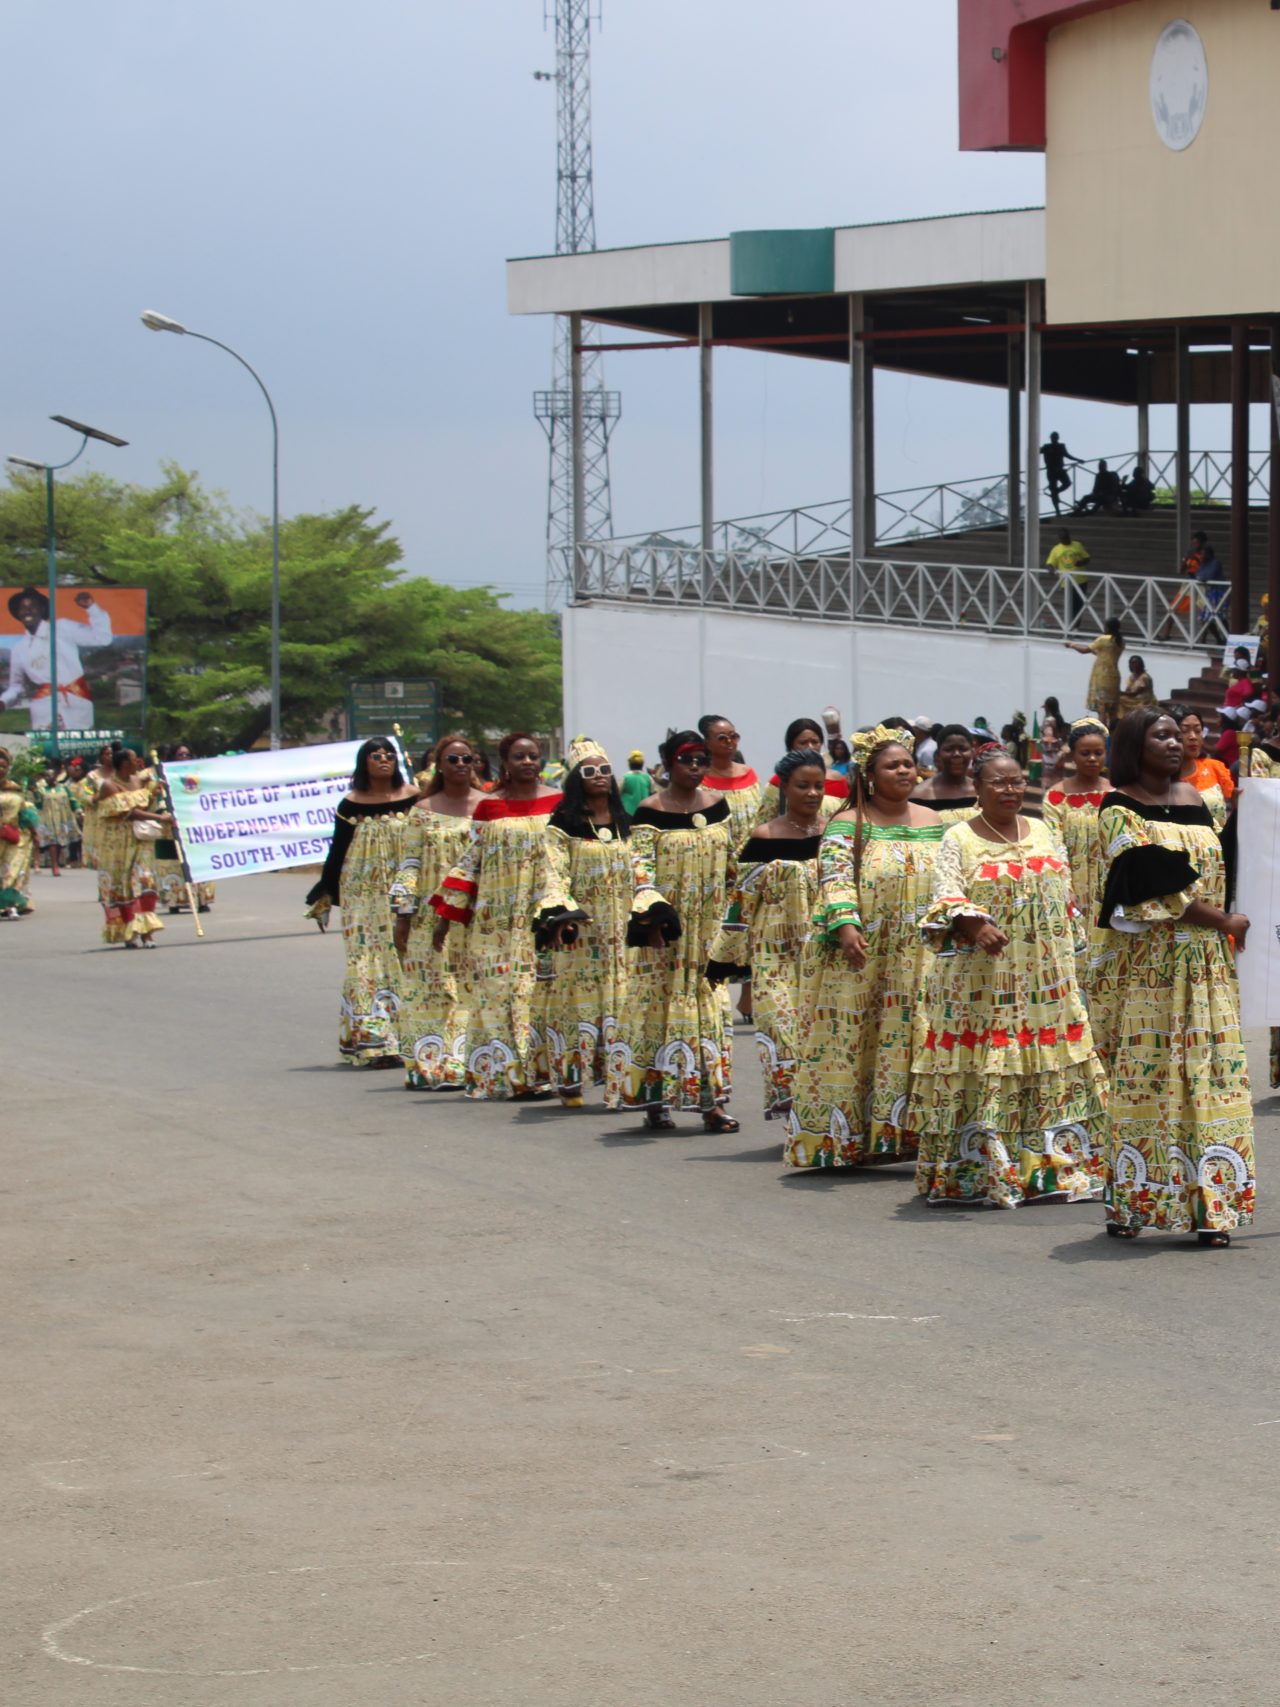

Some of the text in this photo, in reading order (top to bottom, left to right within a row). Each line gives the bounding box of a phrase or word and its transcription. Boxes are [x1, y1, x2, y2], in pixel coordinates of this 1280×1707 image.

[199, 788, 258, 812] OFFICE
[261, 785, 281, 803] OF
[285, 779, 320, 800] THE
[186, 812, 301, 845] INDEPENDENT
